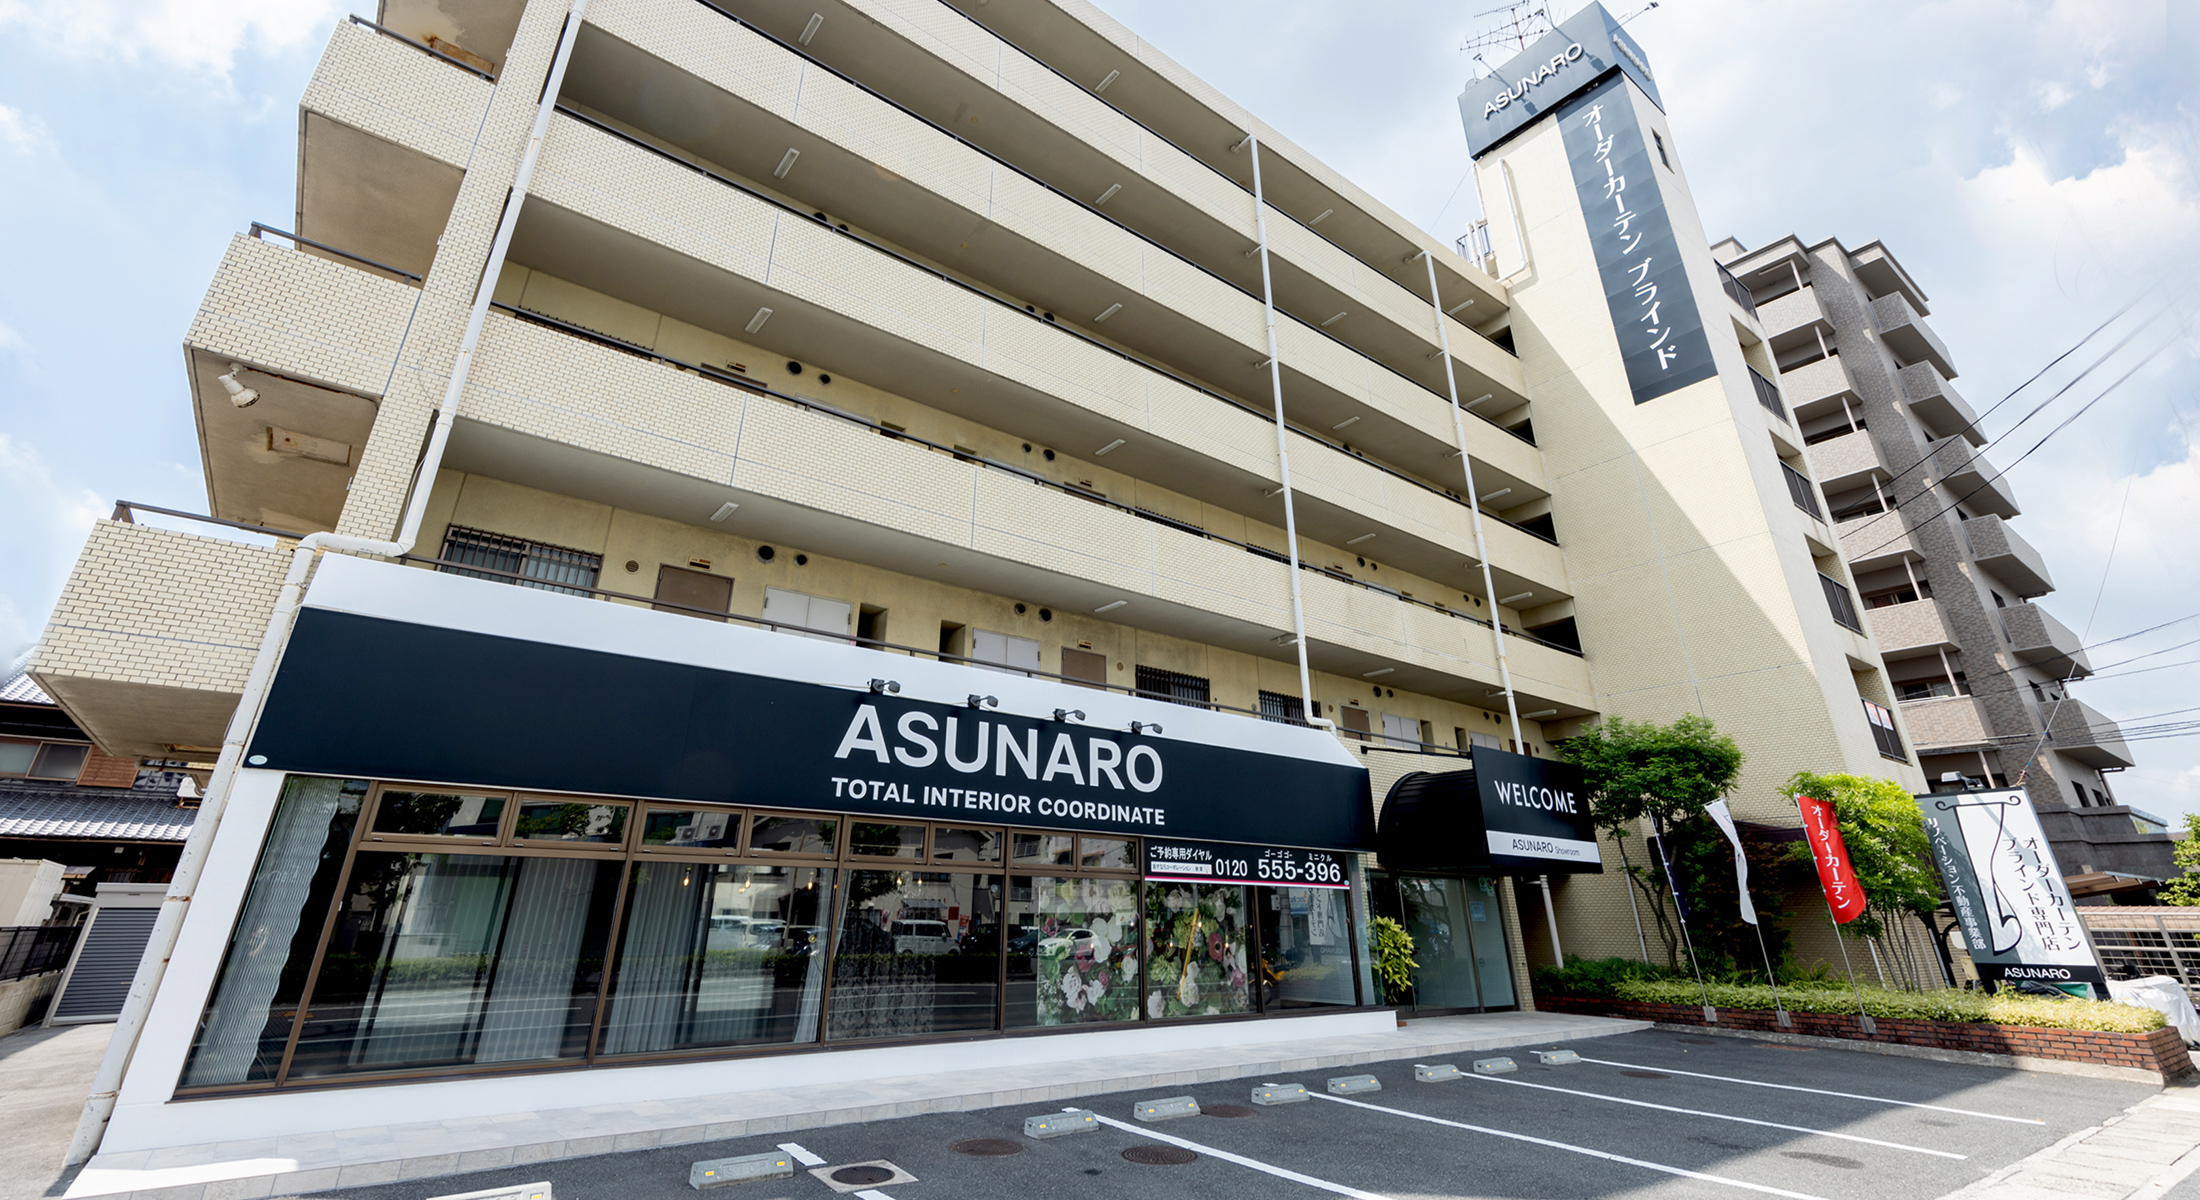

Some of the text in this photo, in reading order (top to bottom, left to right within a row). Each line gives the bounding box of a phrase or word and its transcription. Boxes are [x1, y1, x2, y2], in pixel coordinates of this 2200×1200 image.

[1483, 42, 1583, 119] ASUNARO
[1583, 104, 1642, 255] オーダーカーテン
[1628, 258, 1677, 370] ブラインド
[834, 704, 1164, 793] ASUNARO
[831, 777, 1165, 826] TOTAL INTERIOR COORDINATE
[1494, 780, 1578, 814] WELCOME
[1150, 845, 1213, 861] ご予約専用ダイヤル
[1215, 858, 1341, 883] 0120 555-396
[1308, 852, 1333, 862] ミニクル
[1512, 839, 1580, 856] ASUNARO Showroom
[1811, 804, 1850, 909] オーダーカーテン
[2002, 837, 2061, 951] ブラインド専門店
[2023, 836, 2081, 950] オーダーカーテン
[2004, 967, 2071, 980] ASUNARO
